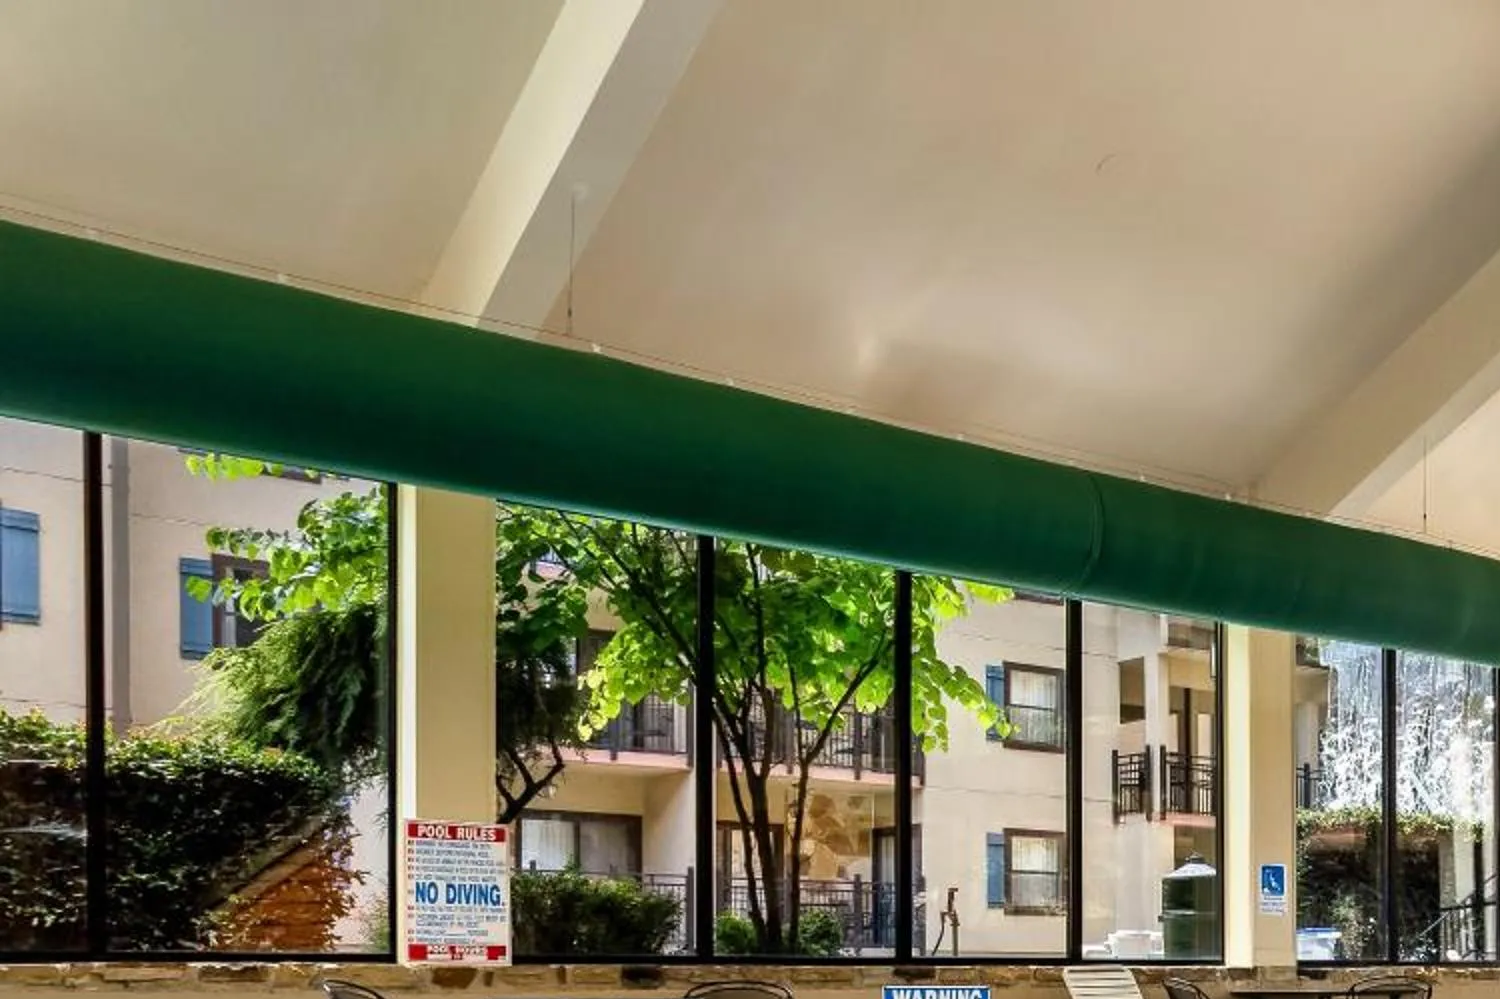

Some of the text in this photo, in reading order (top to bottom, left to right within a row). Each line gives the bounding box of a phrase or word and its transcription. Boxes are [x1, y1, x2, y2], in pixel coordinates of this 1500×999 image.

[417, 825, 496, 840] POOL RULES
[415, 881, 438, 903] NO
